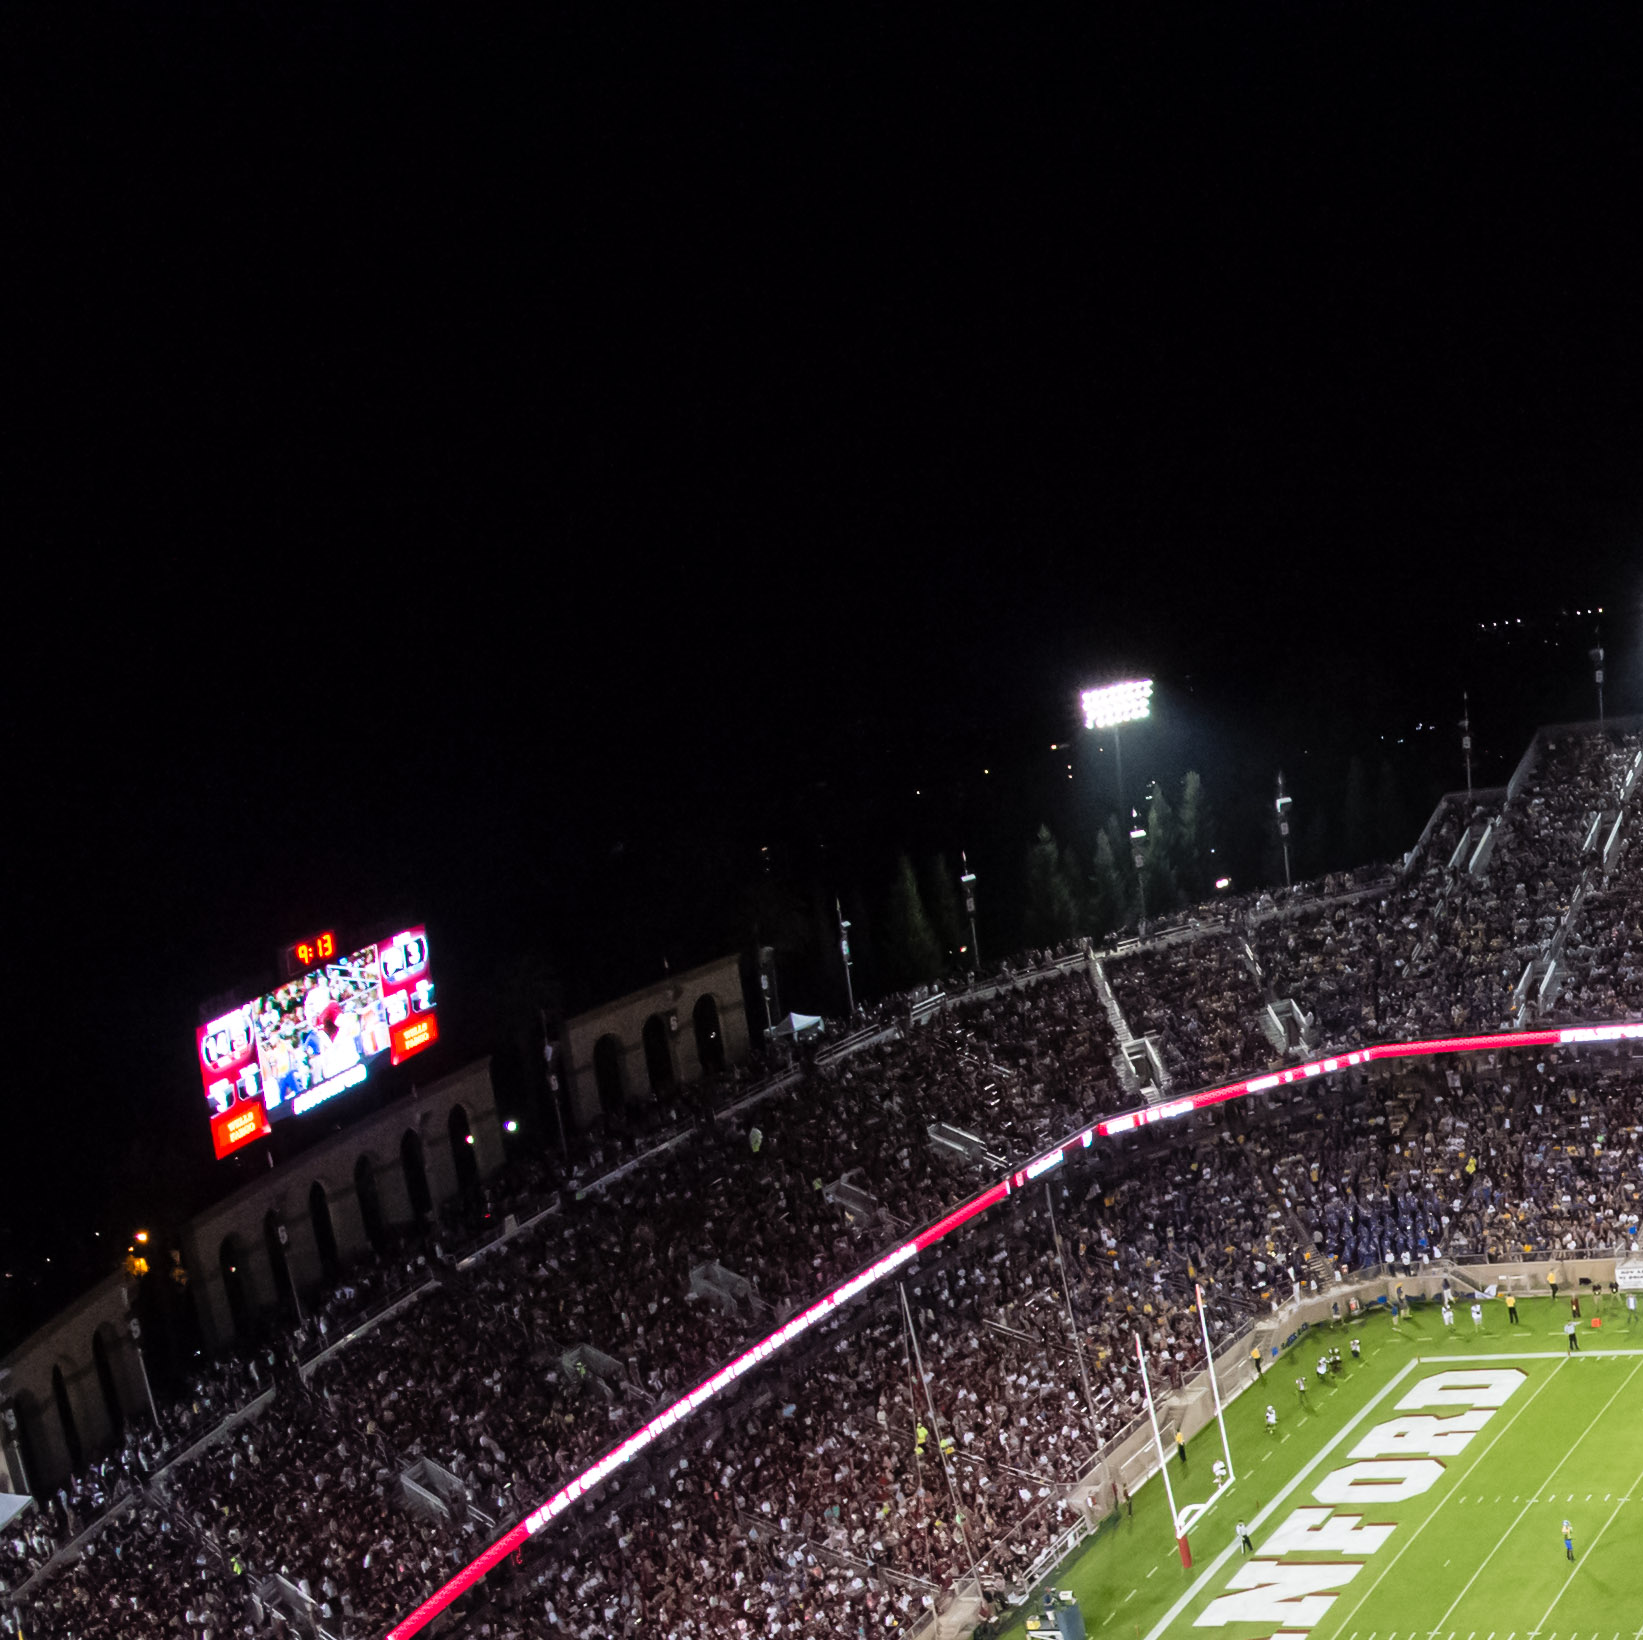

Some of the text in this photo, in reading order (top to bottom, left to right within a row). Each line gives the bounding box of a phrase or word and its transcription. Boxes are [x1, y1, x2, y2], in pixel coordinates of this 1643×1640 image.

[297, 933, 334, 965] 9:13
[403, 1022, 428, 1041] WELLS
[227, 1112, 254, 1132] WELLS
